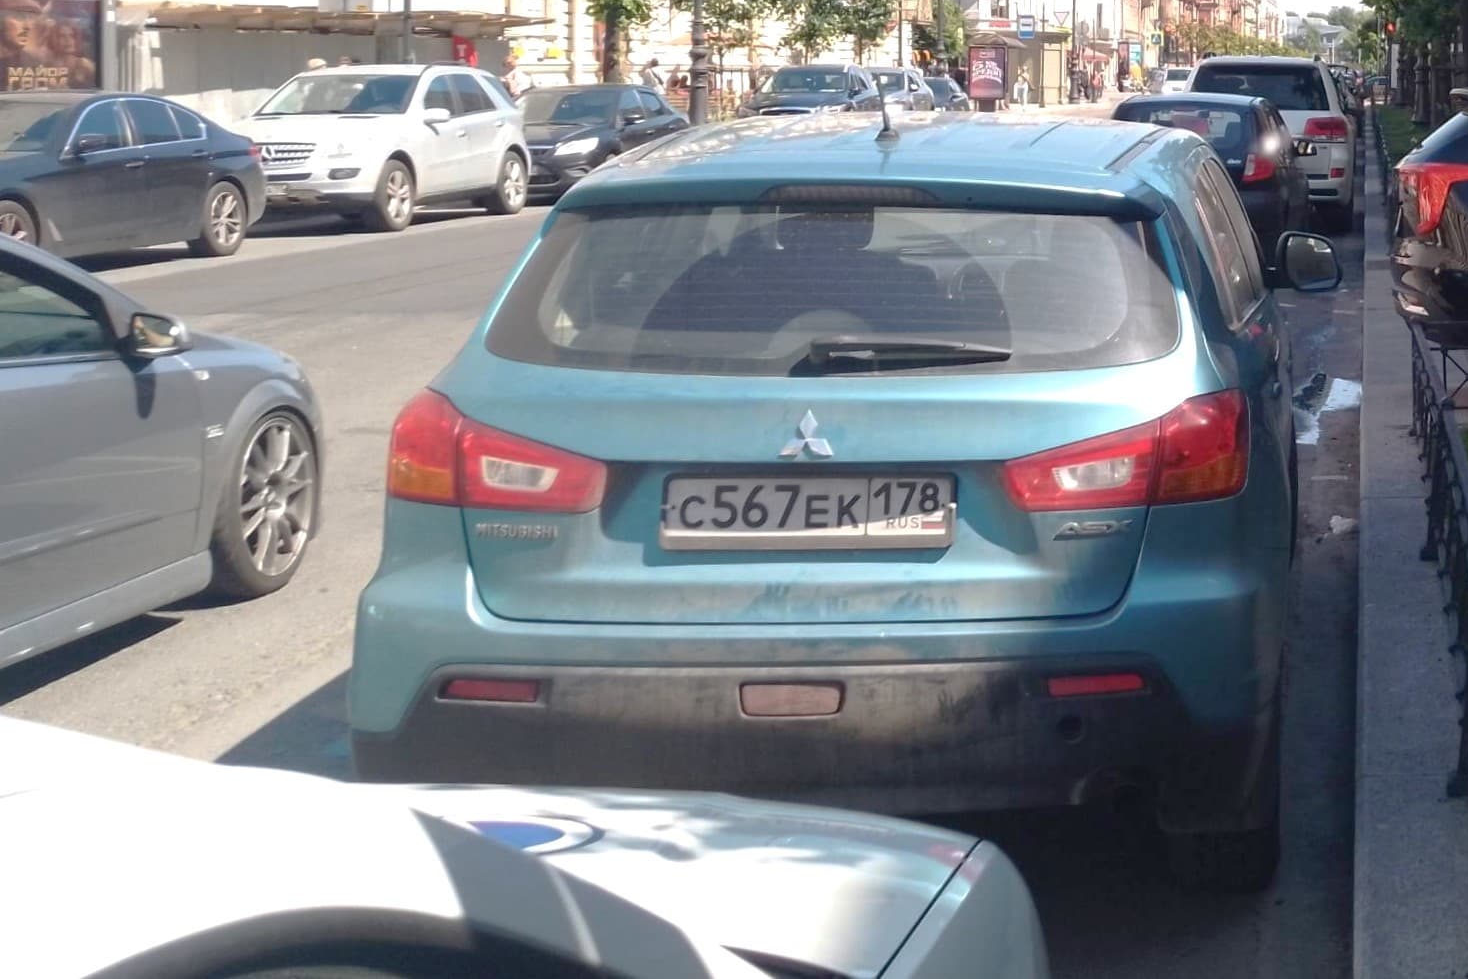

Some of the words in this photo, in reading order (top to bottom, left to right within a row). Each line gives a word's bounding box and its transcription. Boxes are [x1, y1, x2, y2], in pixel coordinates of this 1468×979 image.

[873, 481, 940, 516] 178
[475, 522, 559, 539] MITSUBISHI
[886, 516, 920, 529] RUS
